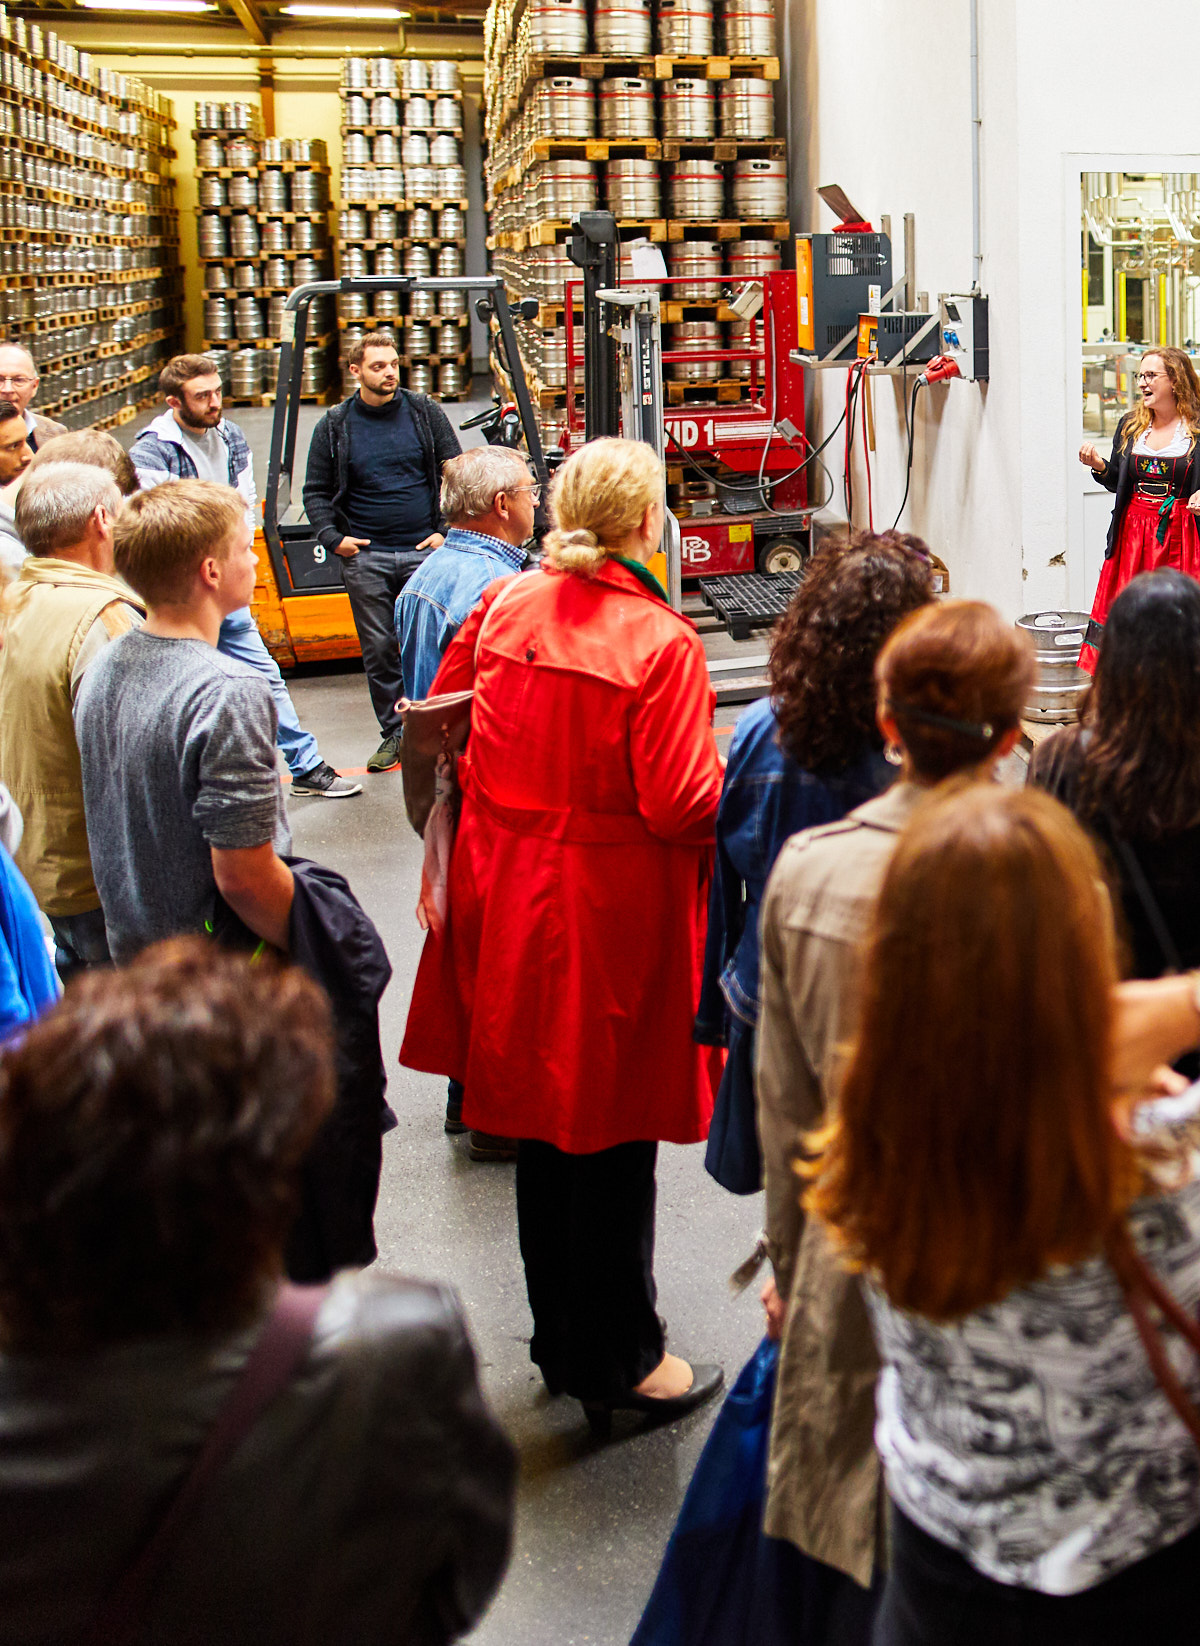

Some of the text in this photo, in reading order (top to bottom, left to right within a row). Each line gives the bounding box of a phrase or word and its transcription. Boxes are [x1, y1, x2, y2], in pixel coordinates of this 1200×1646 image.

[643, 338, 652, 390] STILL
[703, 419, 714, 446] 1
[313, 544, 327, 563] 9
